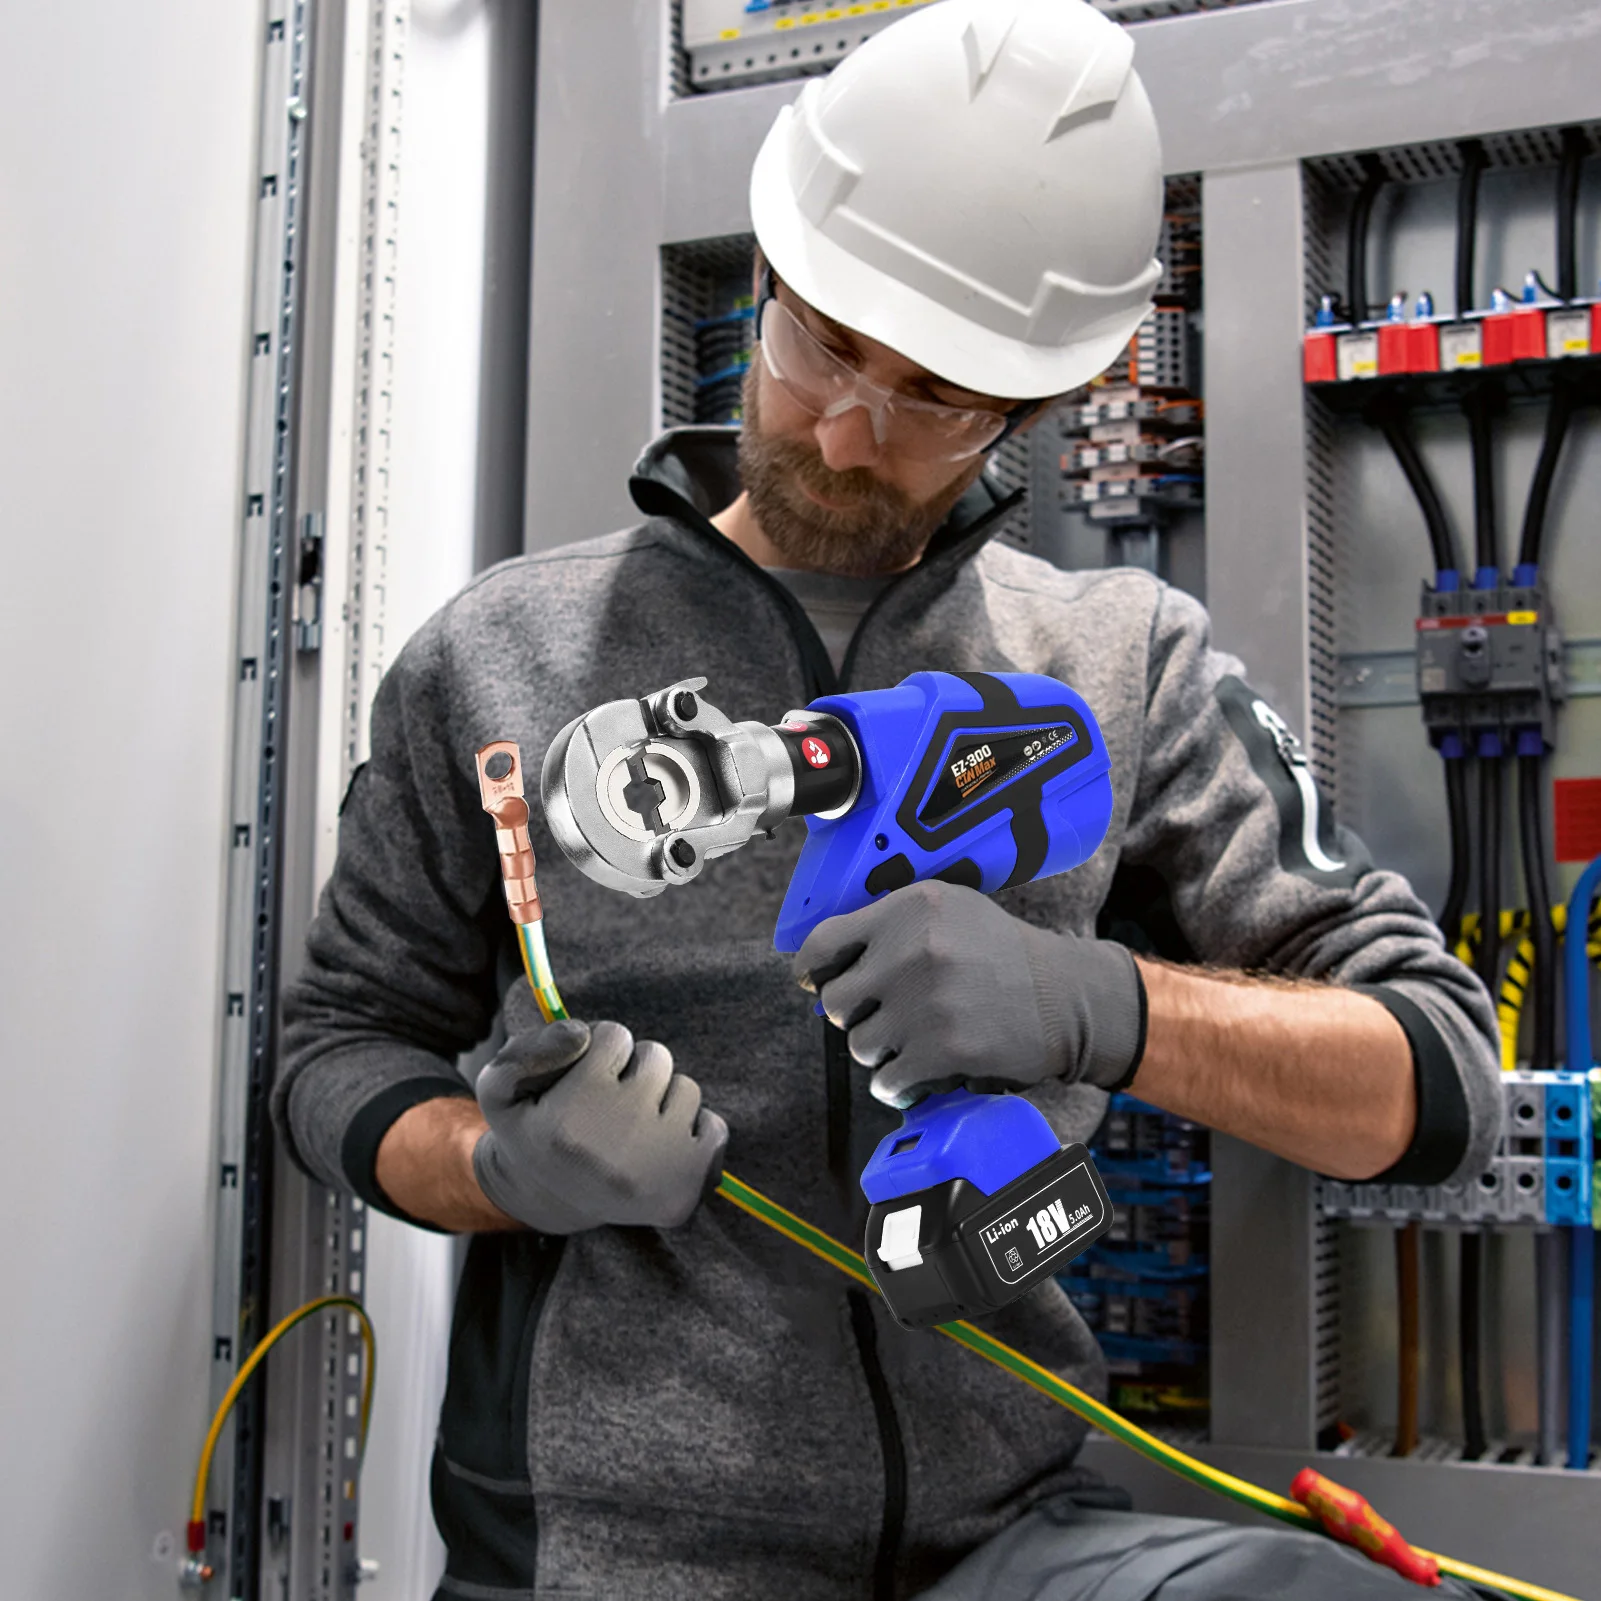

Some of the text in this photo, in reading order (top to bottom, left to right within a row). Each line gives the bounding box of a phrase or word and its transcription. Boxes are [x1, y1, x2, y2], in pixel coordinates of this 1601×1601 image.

[951, 744, 992, 778] EZ-300
[974, 756, 997, 777] Max
[985, 1218, 1019, 1244] Li-ion
[1026, 1198, 1091, 1249] 18V 5.0Ah
